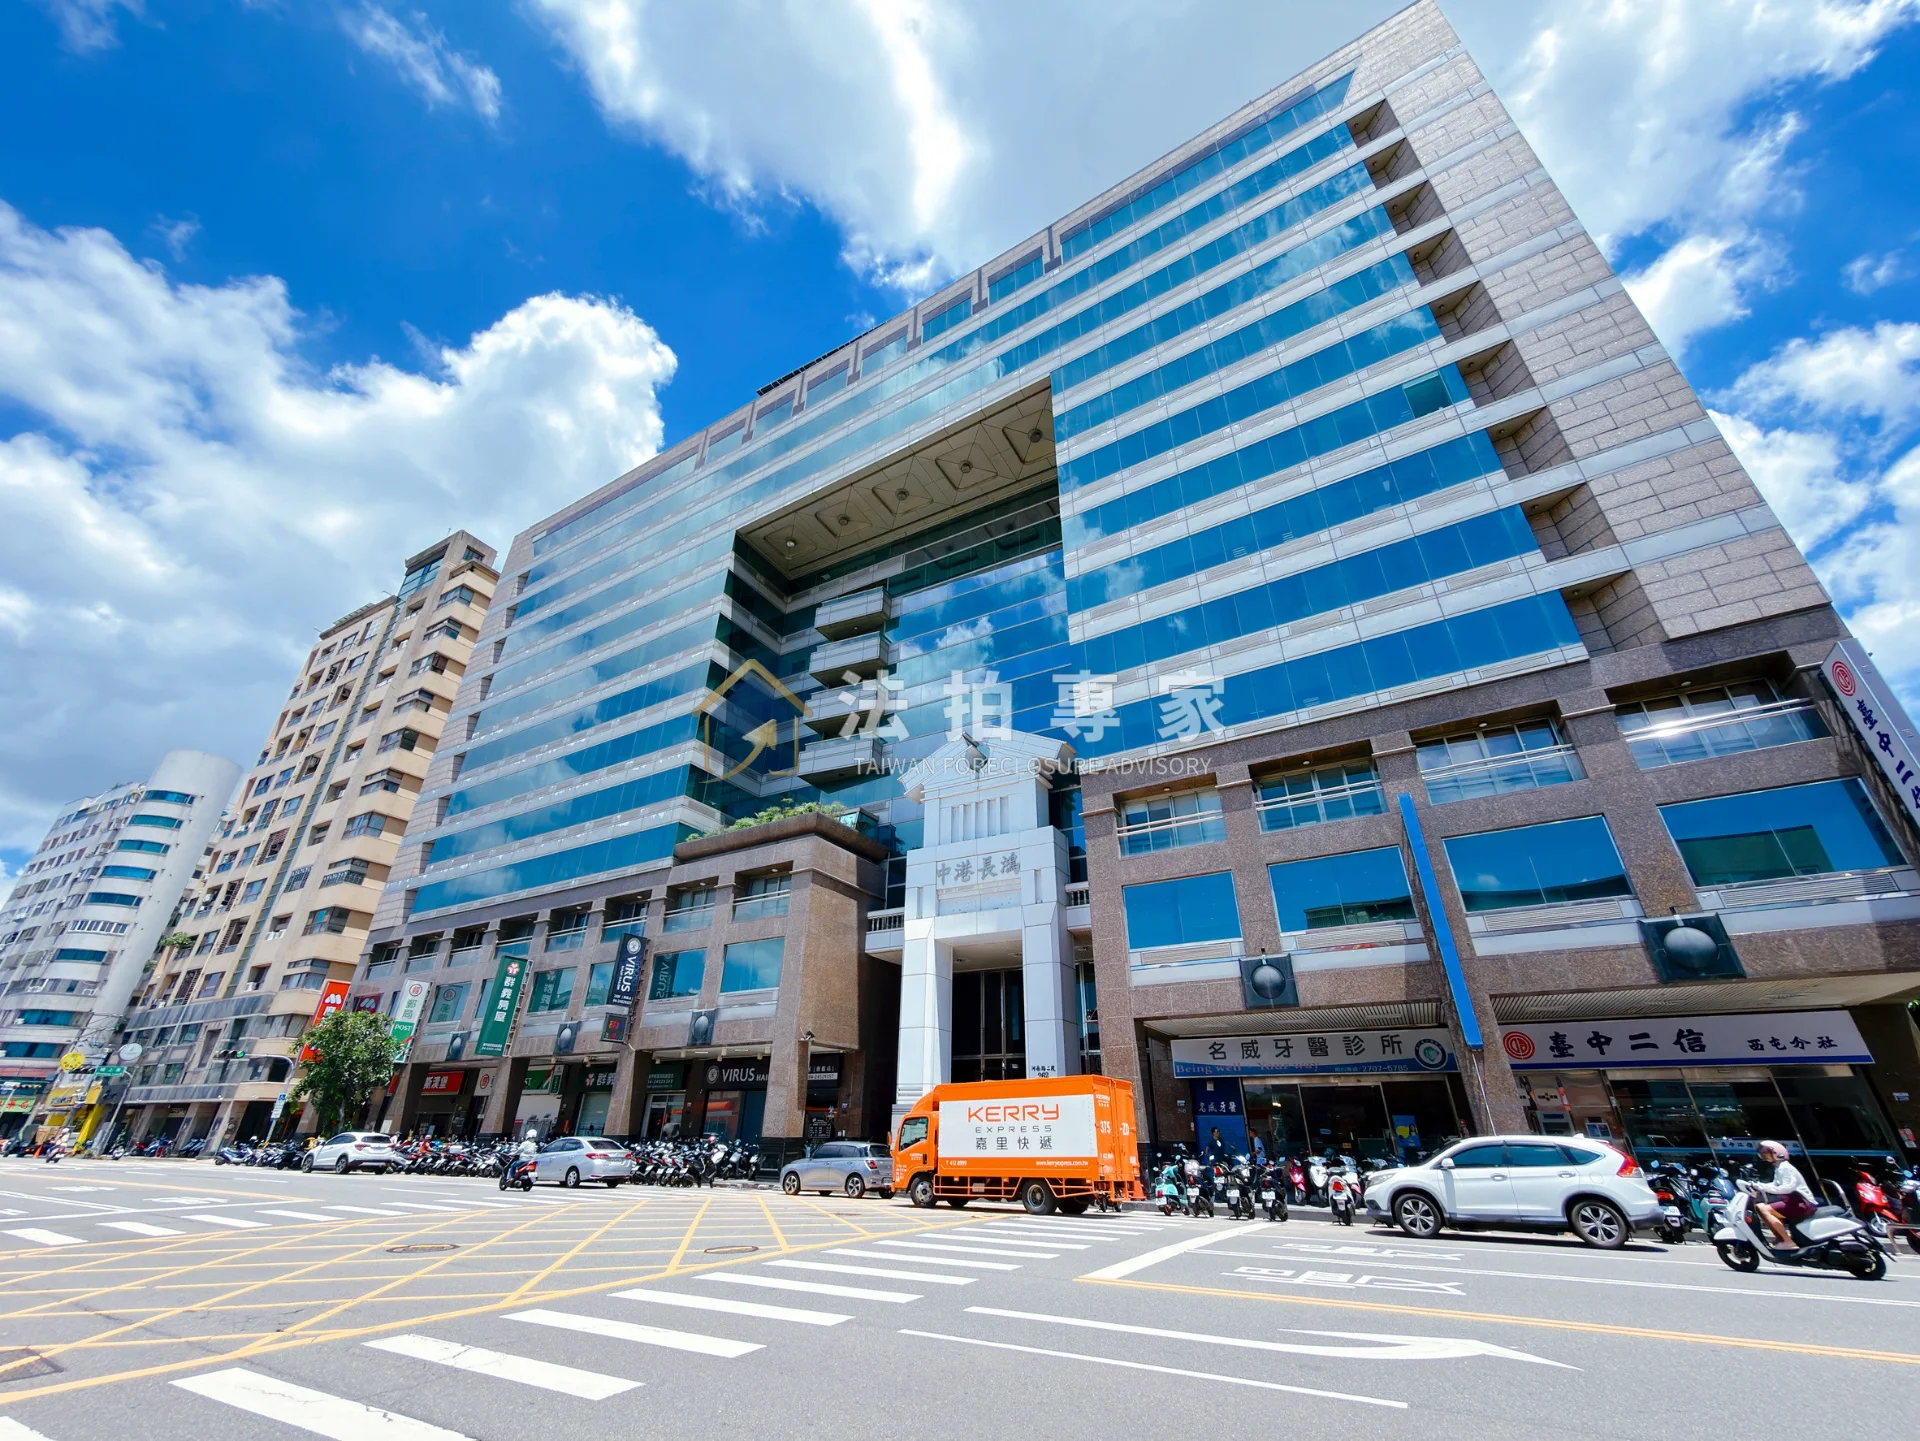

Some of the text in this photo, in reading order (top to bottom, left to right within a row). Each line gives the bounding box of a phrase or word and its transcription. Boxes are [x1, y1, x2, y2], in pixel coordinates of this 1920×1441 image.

[621, 956, 637, 992] VIRUS
[1208, 1034, 1403, 1060] 名威牙醫診所
[1549, 1029, 1707, 1058] 臺中二信
[1747, 1036, 1838, 1051] 西屯分社
[722, 1068, 755, 1082] VIRUS
[1176, 1064, 1213, 1075] Being
[1216, 1062, 1242, 1072] well
[968, 1103, 1060, 1122] KERRY
[975, 1125, 1052, 1133] EXPRESS
[975, 1136, 1053, 1150] 嘉里快遞
